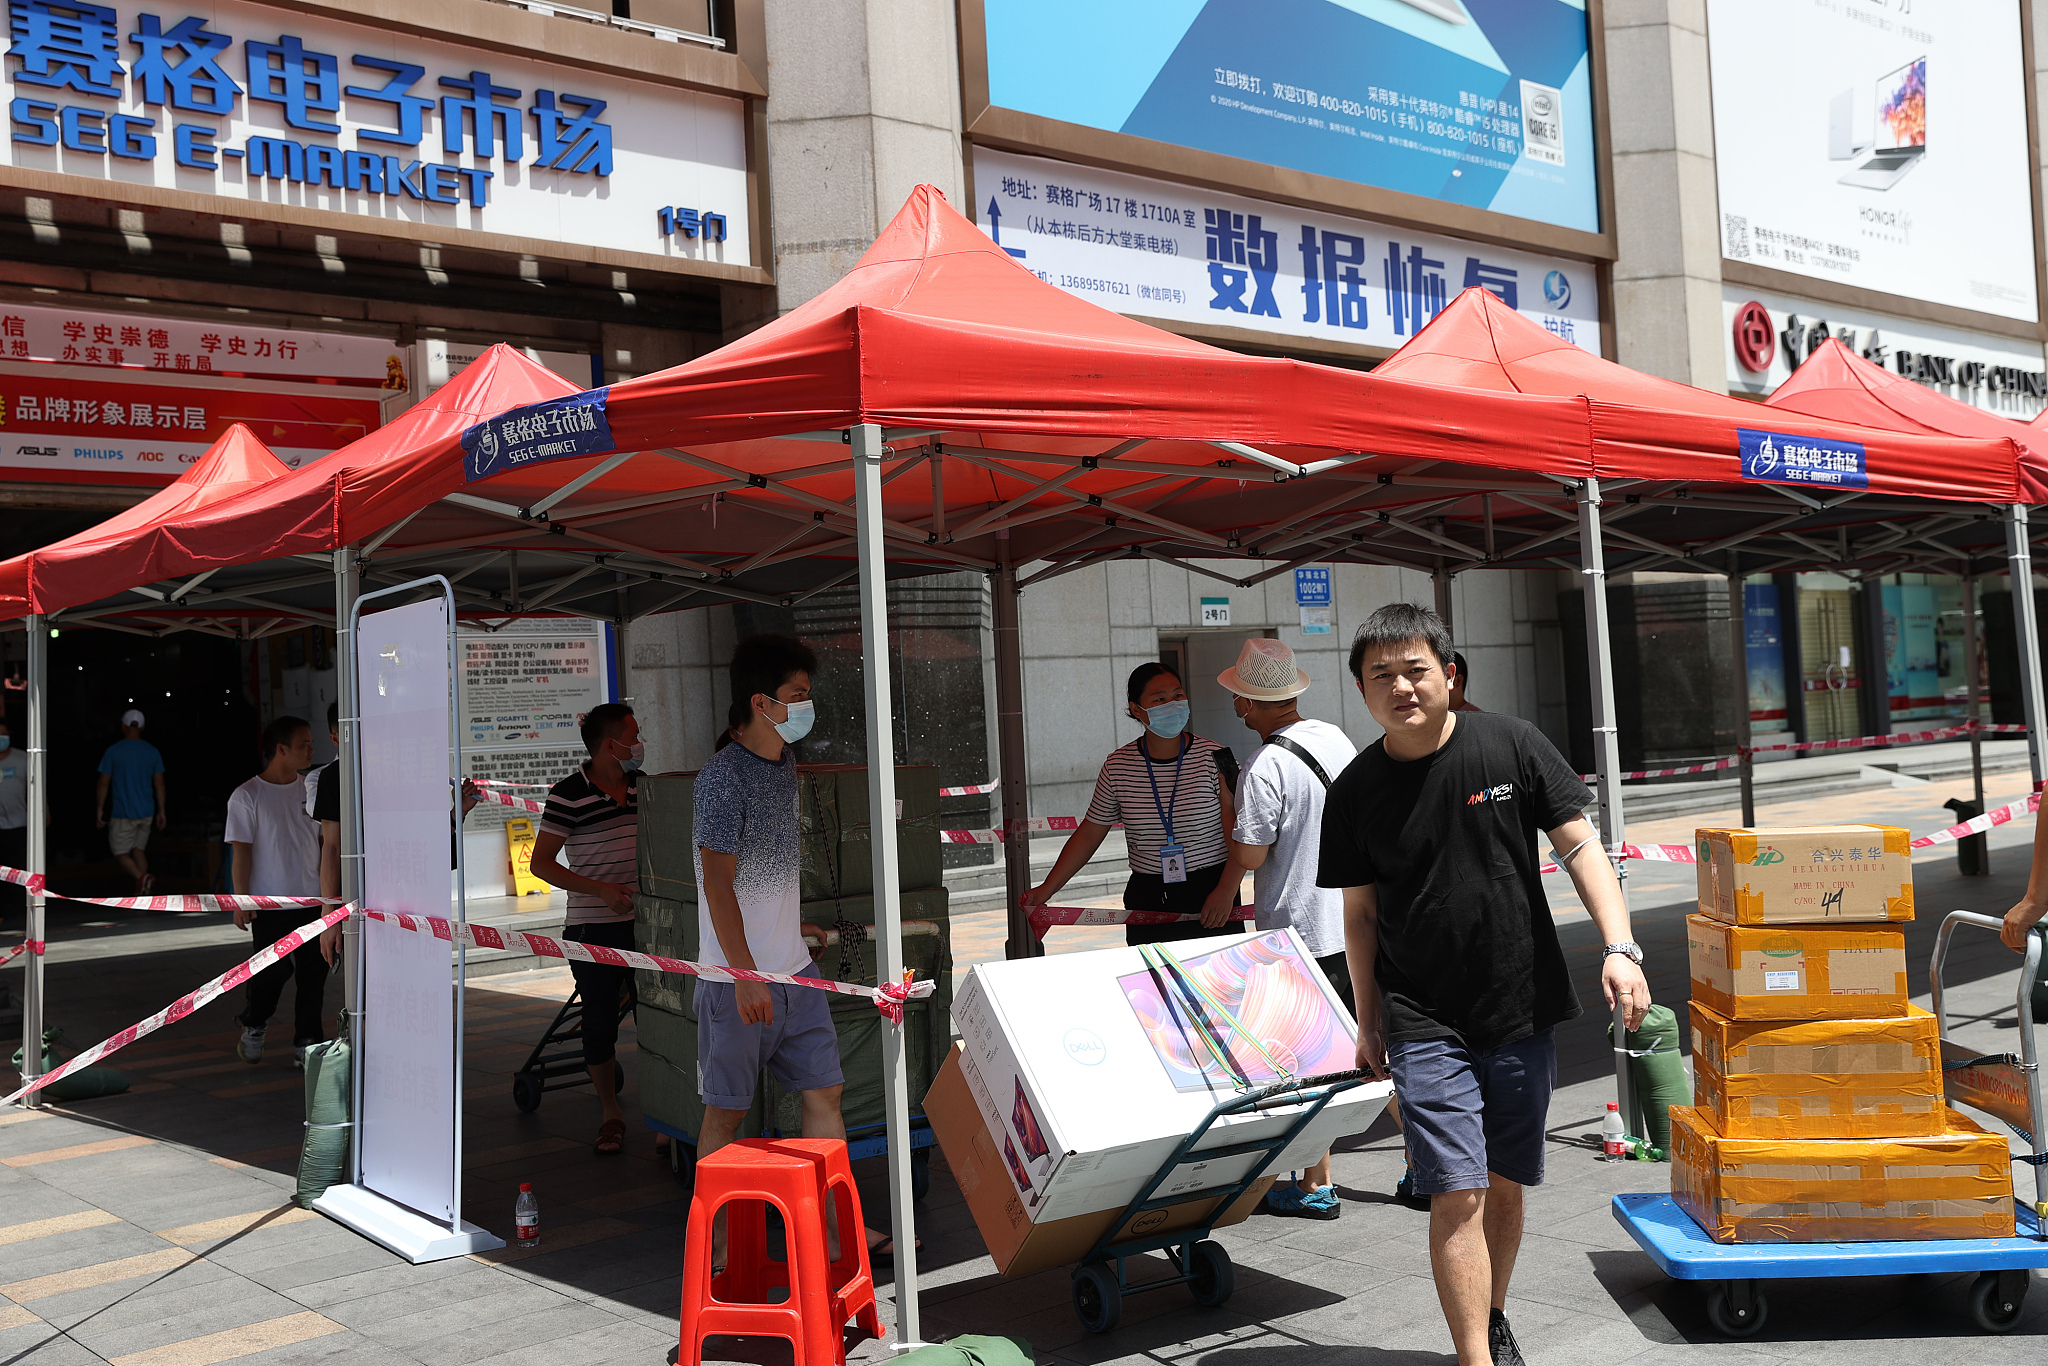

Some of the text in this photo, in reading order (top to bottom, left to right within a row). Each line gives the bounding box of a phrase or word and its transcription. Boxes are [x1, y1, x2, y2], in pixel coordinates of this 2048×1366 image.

[4, 0, 613, 178] 赛格电子市场
[10, 97, 494, 209] SEG E-MARKET
[658, 206, 728, 242] 1号门
[1106, 197, 1121, 214] 17
[1124, 198, 1138, 219] 楼
[1141, 203, 1181, 225] 1710A
[1183, 209, 1196, 228] 室
[1859, 205, 1896, 228] HONOR
[63, 321, 170, 350] 学史崇德
[201, 333, 299, 361] 学史力行
[62, 344, 213, 372] 办实事 开新局
[1896, 350, 1955, 385] BANK
[1958, 360, 1986, 389] OF
[16, 395, 207, 431] 品牌形象展示层
[502, 404, 597, 447] 赛格电子市场
[16, 446, 164, 462] ASUS PHILIPS AOC
[508, 439, 577, 464] SEG E-MARKET
[1783, 445, 1858, 473] 赛格电子市场
[1785, 468, 1842, 483] SEG E-MARKET
[1205, 609, 1227, 621] 2号门
[1811, 847, 1882, 864] 合兴泰华
[1793, 882, 1812, 890] MADE
[1832, 881, 1855, 889] CHINA
[1794, 897, 1816, 905] C/NO:
[1069, 1041, 1101, 1053] DELL
[1135, 1215, 1163, 1229] DELL
